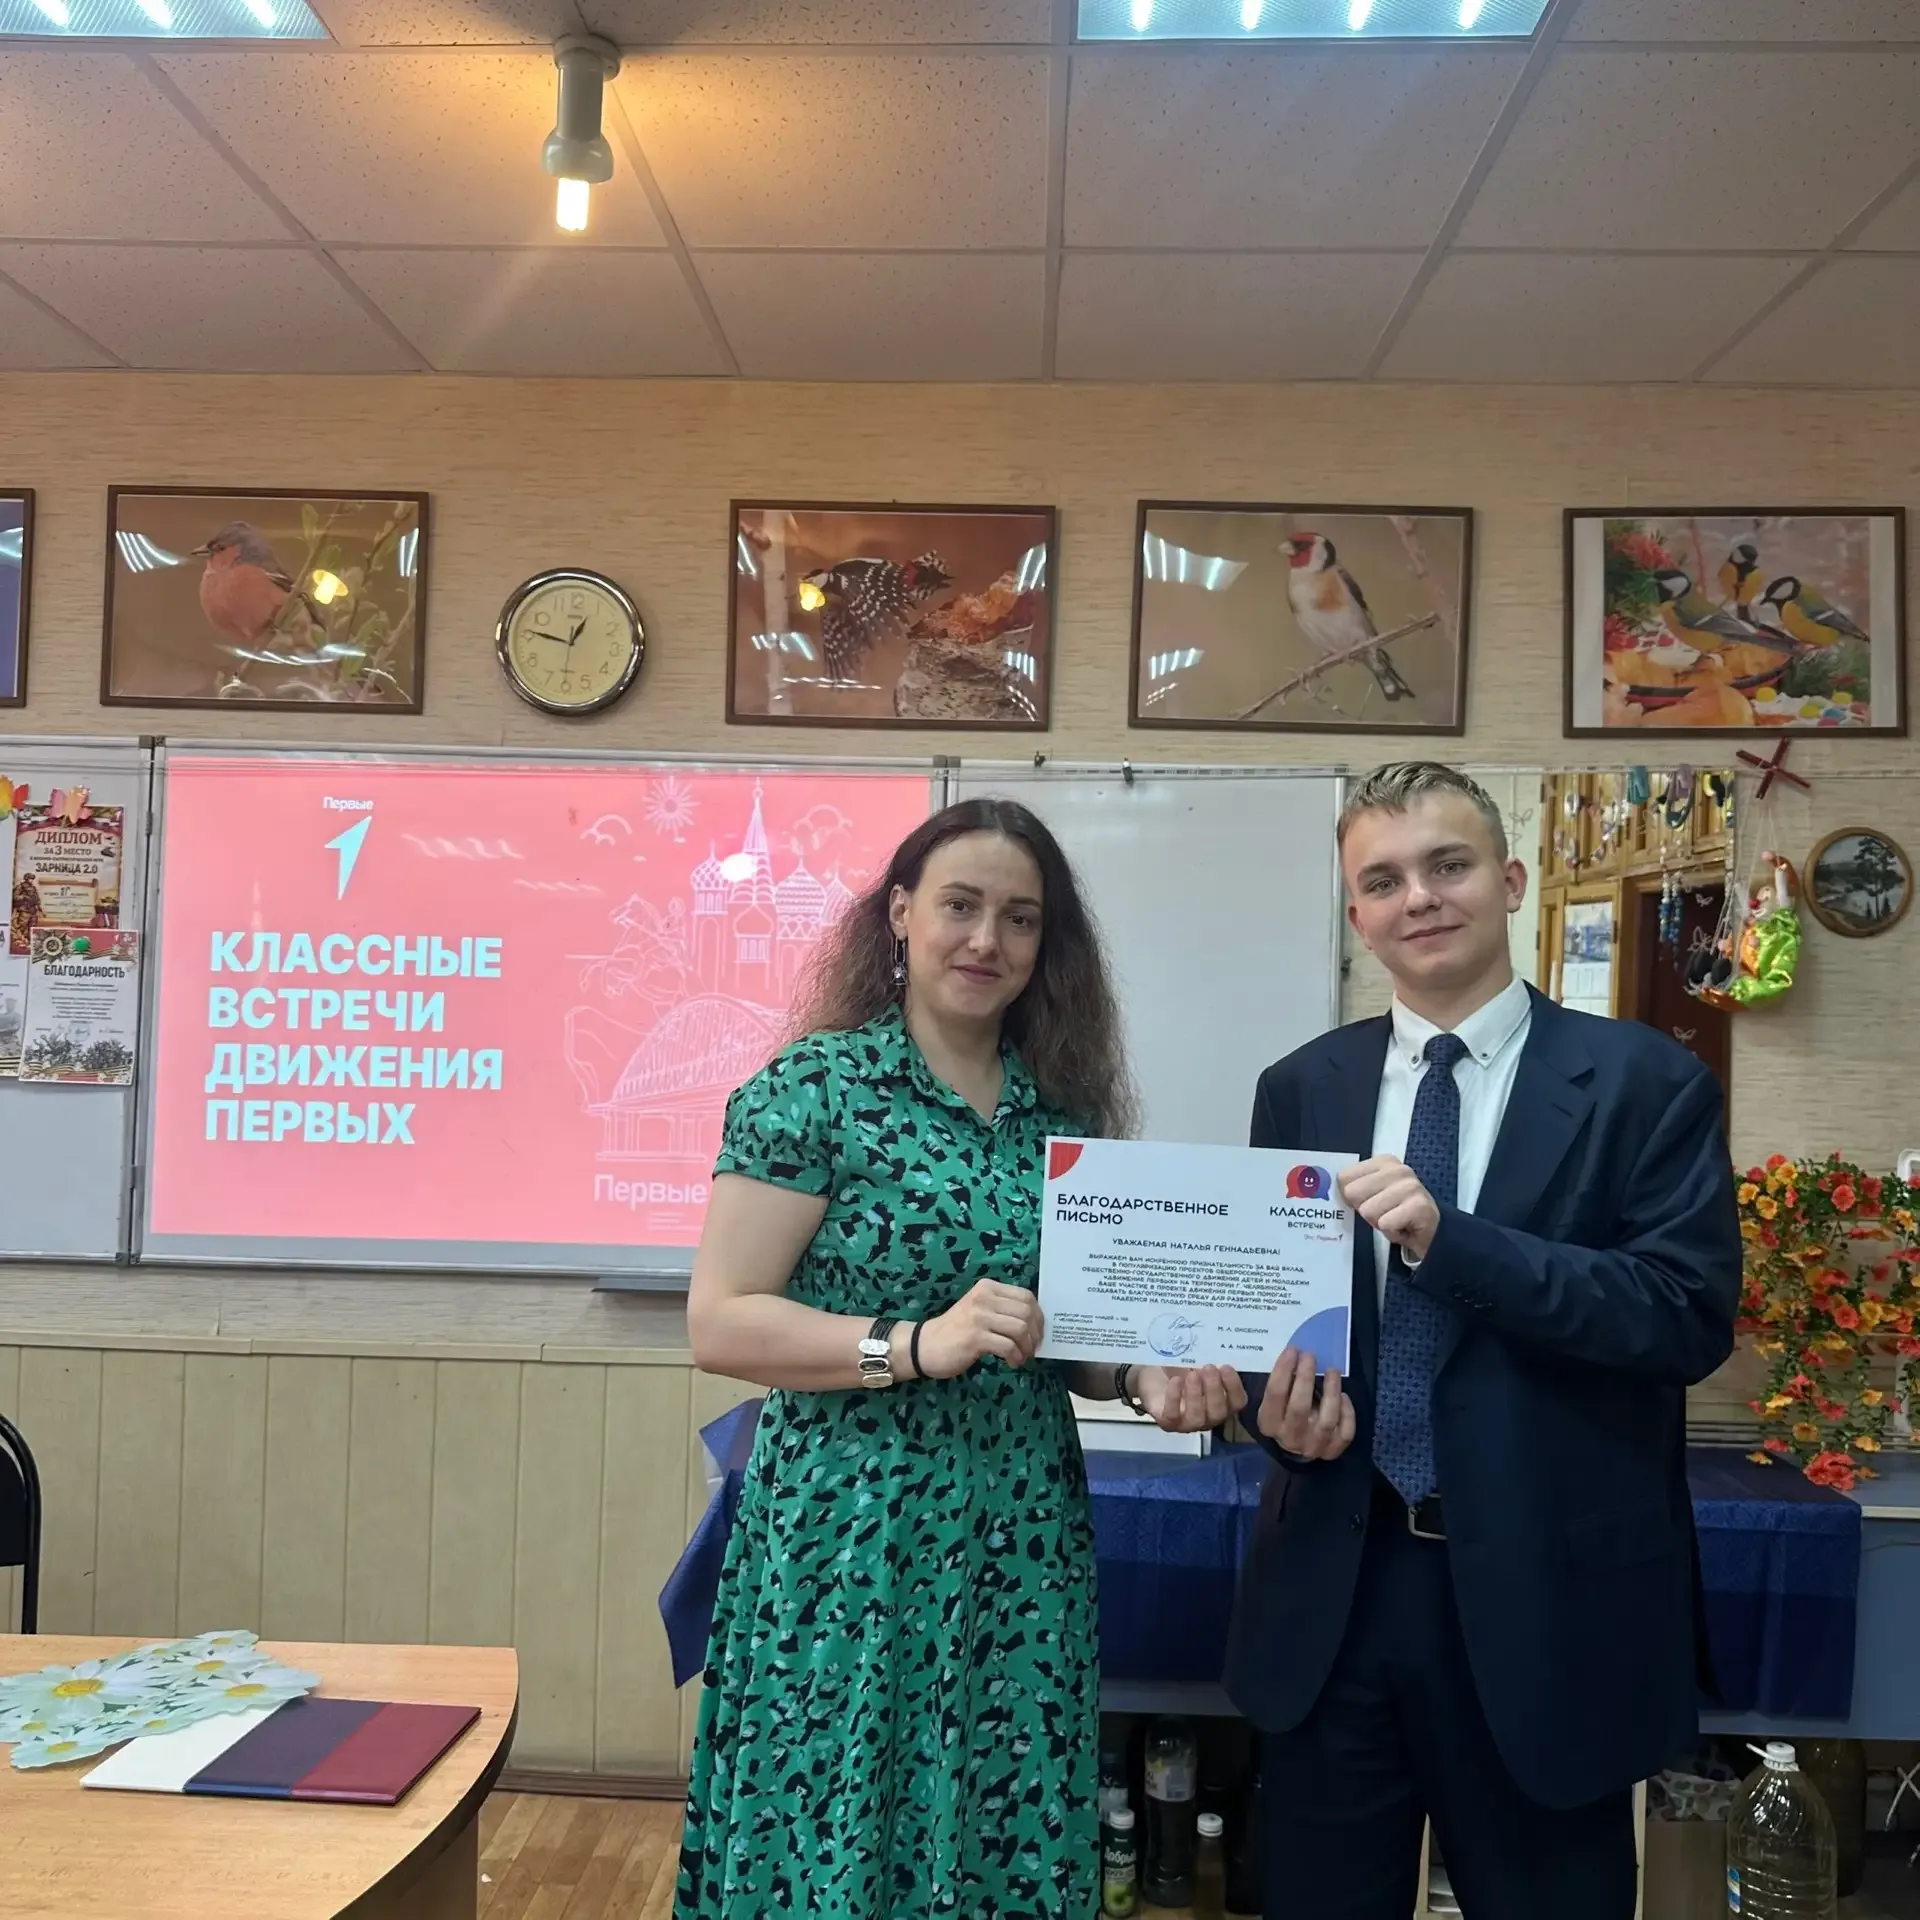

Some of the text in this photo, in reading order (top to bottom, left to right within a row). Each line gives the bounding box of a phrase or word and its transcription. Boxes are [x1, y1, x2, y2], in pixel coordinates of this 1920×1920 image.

[571, 592, 585, 609] 12
[606, 622, 619, 637] 2
[609, 642, 621, 657] 3
[527, 652, 538, 667] 8
[599, 661, 609, 675] 4
[543, 670, 554, 686] 7
[580, 674, 592, 690] 5
[323, 796, 374, 812] Первые
[35, 831, 102, 845] ДИПЛОМ
[55, 846, 62, 856] 3
[63, 848, 92, 856] МЕСТО
[35, 862, 98, 875] ЗАРНИЦА 2.0
[210, 930, 503, 978] КЛАССНЫЕ
[44, 965, 125, 978] БЛАГОДАРНОСТЬ
[208, 987, 446, 1032] ВСТРЕЧИ
[204, 1042, 503, 1094] ДВИЖЕНИЯ
[205, 1099, 416, 1145] ПЕРВЫХ
[594, 1174, 708, 1212] Первые
[1057, 1193, 1229, 1216] БЛАГОДАРСТВЕННОЕ
[1056, 1209, 1123, 1225] ПИСЬМО
[1269, 1206, 1345, 1220] КЛАССНЫЕ
[1287, 1221, 1326, 1229] ВСТРЕЧИ
[1112, 1238, 1280, 1255] УВАЖАЕМАЯ НАТАЛЬЯ ГЕННАДЬЕВНА!
[1089, 1253, 1127, 1261] ВЫРАЖАЕМ
[1179, 1266, 1213, 1274] ПРОЕКТОВ
